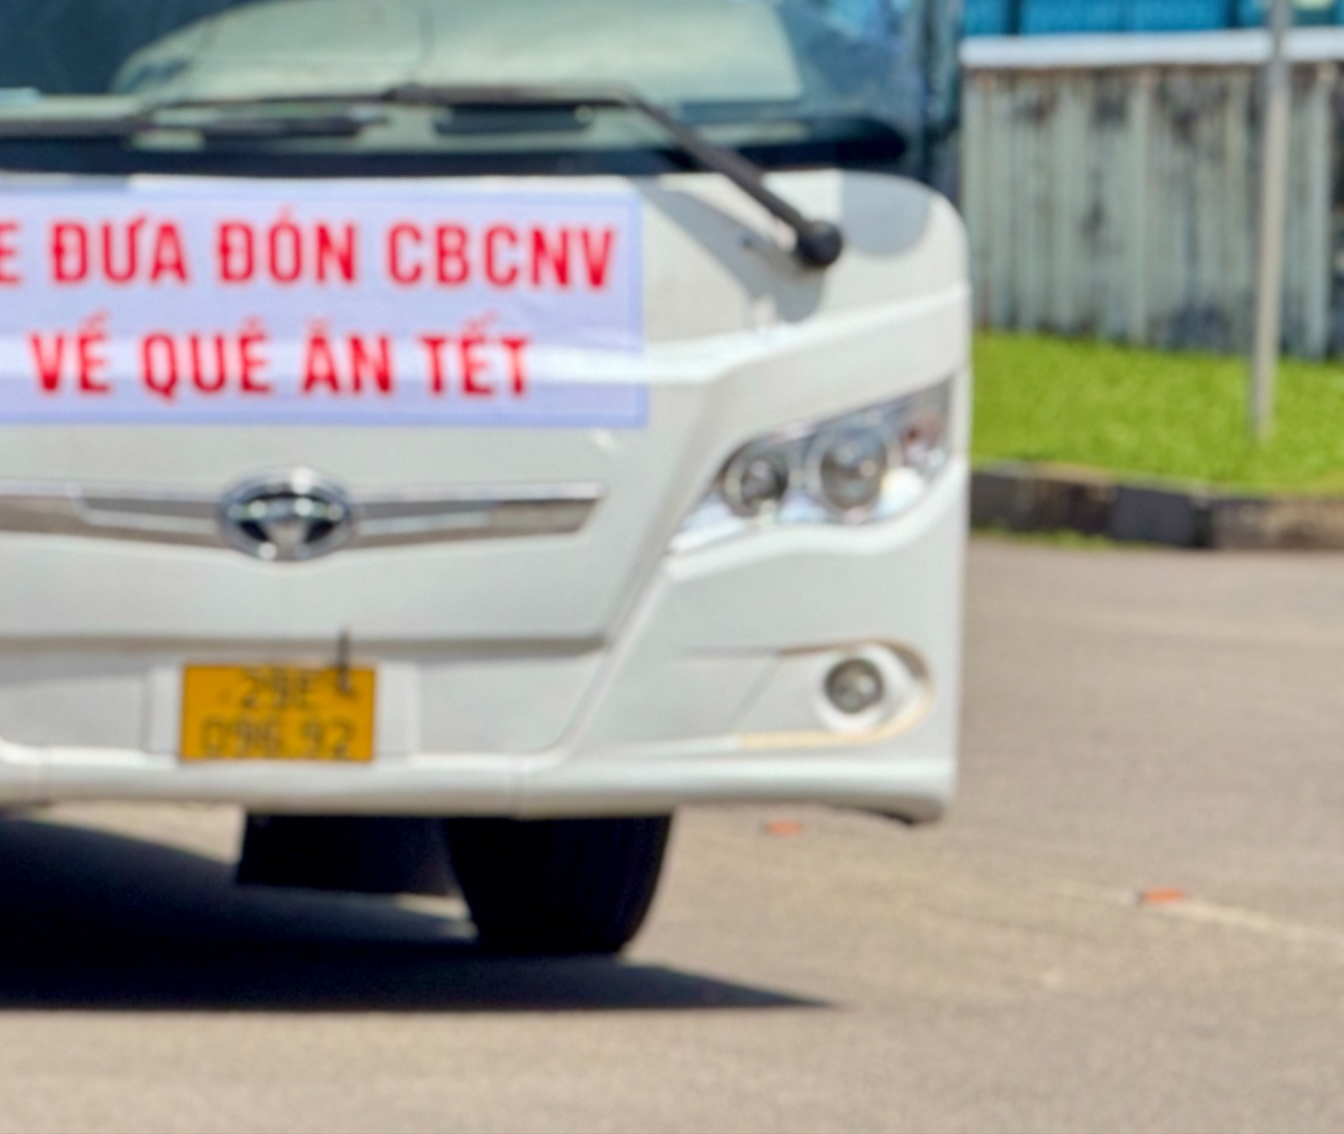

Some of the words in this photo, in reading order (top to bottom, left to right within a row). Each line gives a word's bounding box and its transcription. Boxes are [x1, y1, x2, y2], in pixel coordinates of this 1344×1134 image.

[48, 211, 189, 284] ĐƯA
[214, 204, 357, 285] ĐÓN
[386, 222, 615, 289] CBCNV
[140, 314, 275, 402] QUÊ
[418, 308, 530, 395] TẾT
